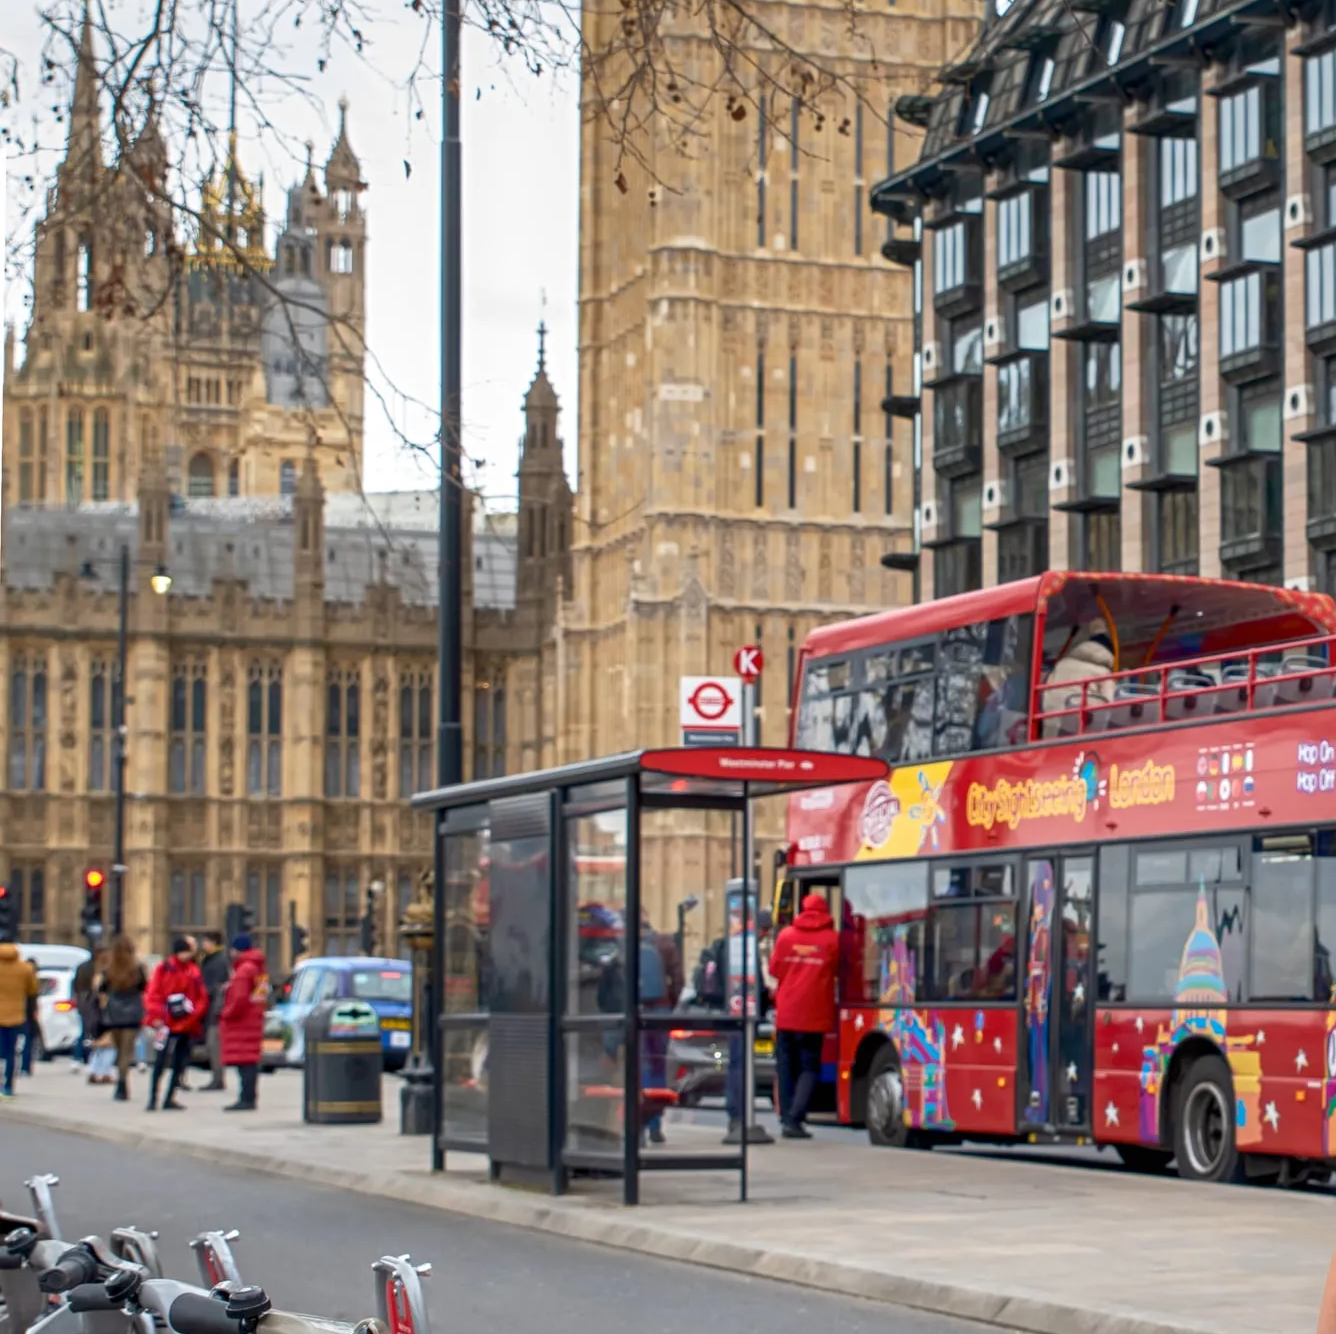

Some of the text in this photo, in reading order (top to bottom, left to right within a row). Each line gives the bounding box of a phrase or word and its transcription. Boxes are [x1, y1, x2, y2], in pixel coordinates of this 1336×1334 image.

[739, 649, 761, 675] K
[1297, 739, 1335, 765] Hop On
[1109, 758, 1175, 809] London
[1296, 768, 1336, 794] Hop Off
